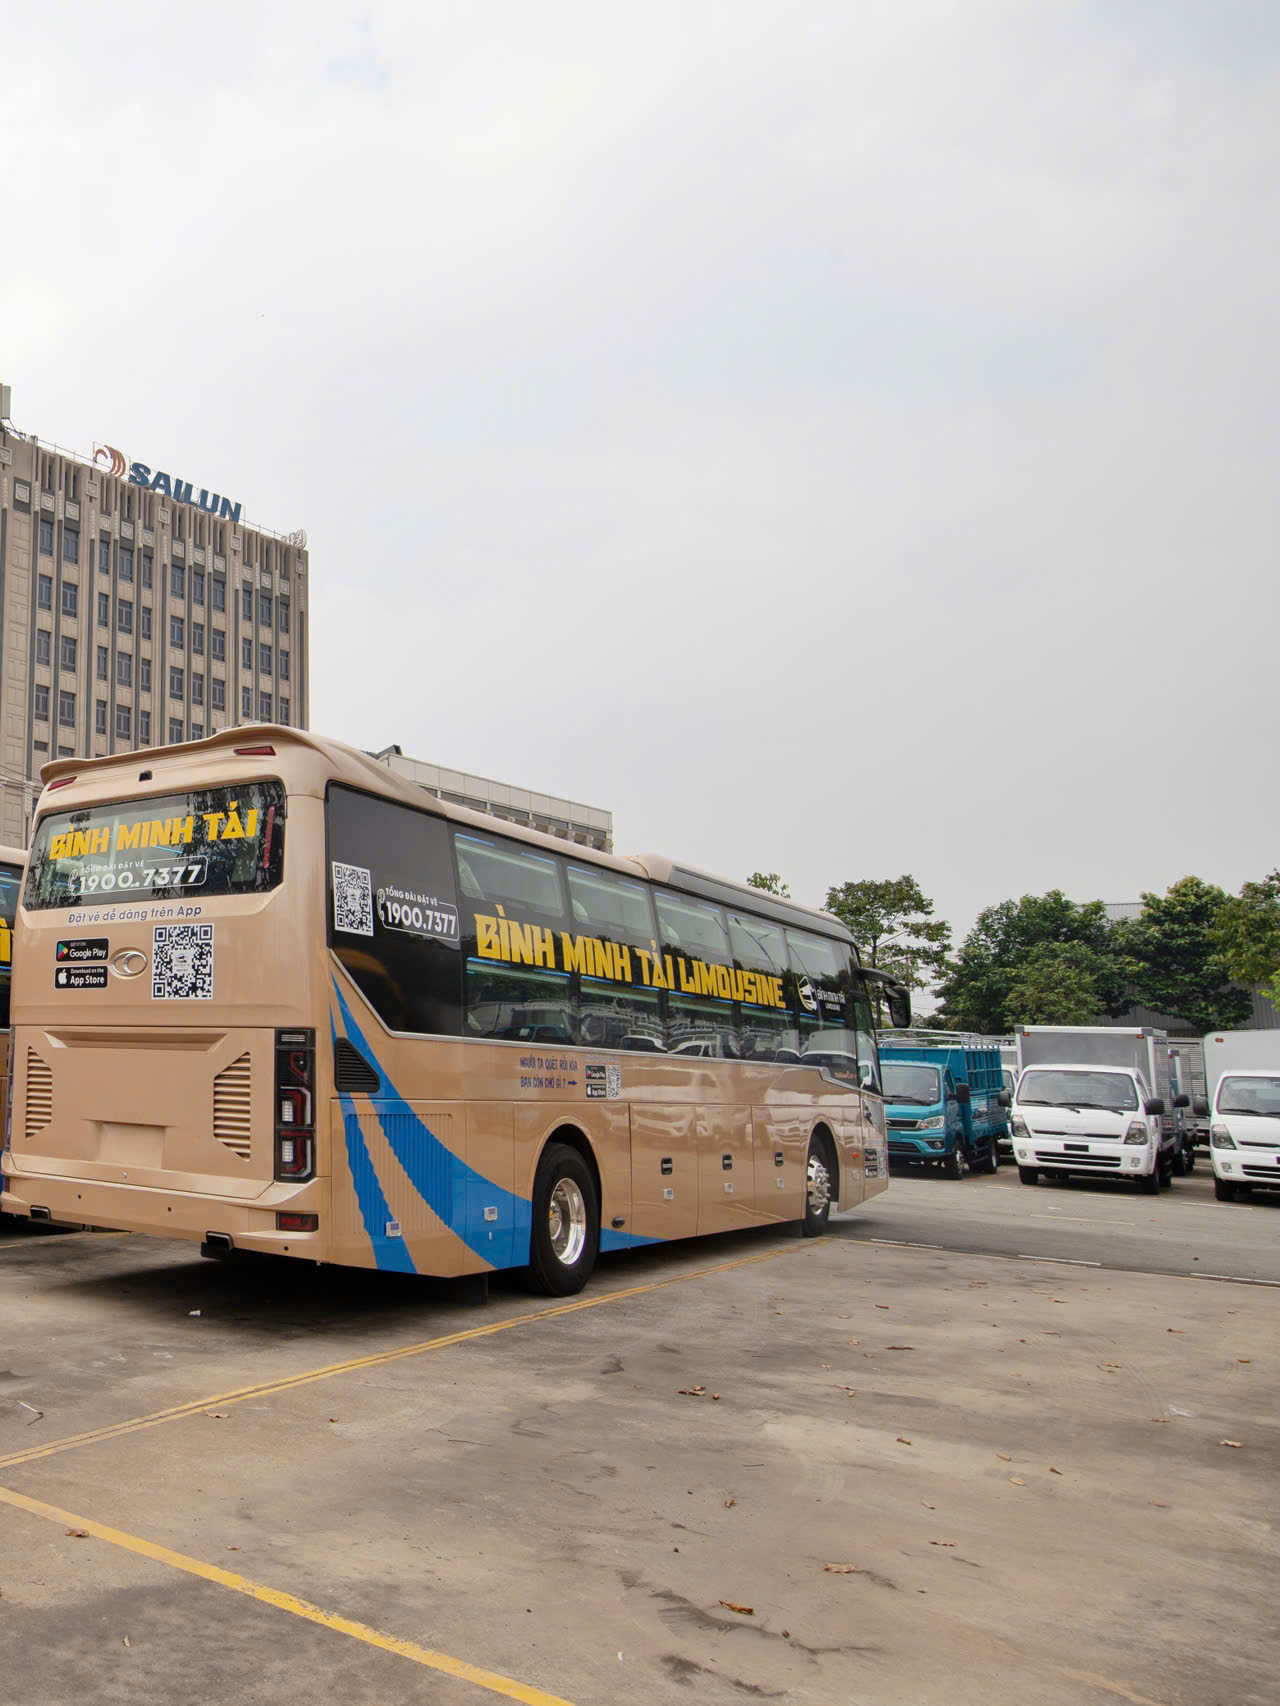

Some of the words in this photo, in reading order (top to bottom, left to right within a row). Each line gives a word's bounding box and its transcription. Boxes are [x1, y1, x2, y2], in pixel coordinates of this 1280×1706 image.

[129, 462, 242, 522] SAILUN
[49, 824, 110, 860] BÌNH
[116, 815, 194, 850] MINH
[203, 800, 259, 841] TẢI
[80, 865, 202, 894] 1900.7377
[69, 913, 86, 925] Đặt
[88, 912, 100, 922] vé
[119, 908, 148, 921] dàng
[151, 906, 173, 918] trên
[176, 906, 202, 917] App
[386, 901, 456, 935] 1900.7377
[69, 949, 92, 959] Google
[93, 949, 107, 959] Play
[474, 904, 556, 968] BÌNH
[560, 931, 632, 982] MINH
[634, 937, 675, 990] TẢI
[677, 956, 787, 1009] LIMOUSINE
[70, 976, 84, 986] App
[85, 976, 105, 985] Store
